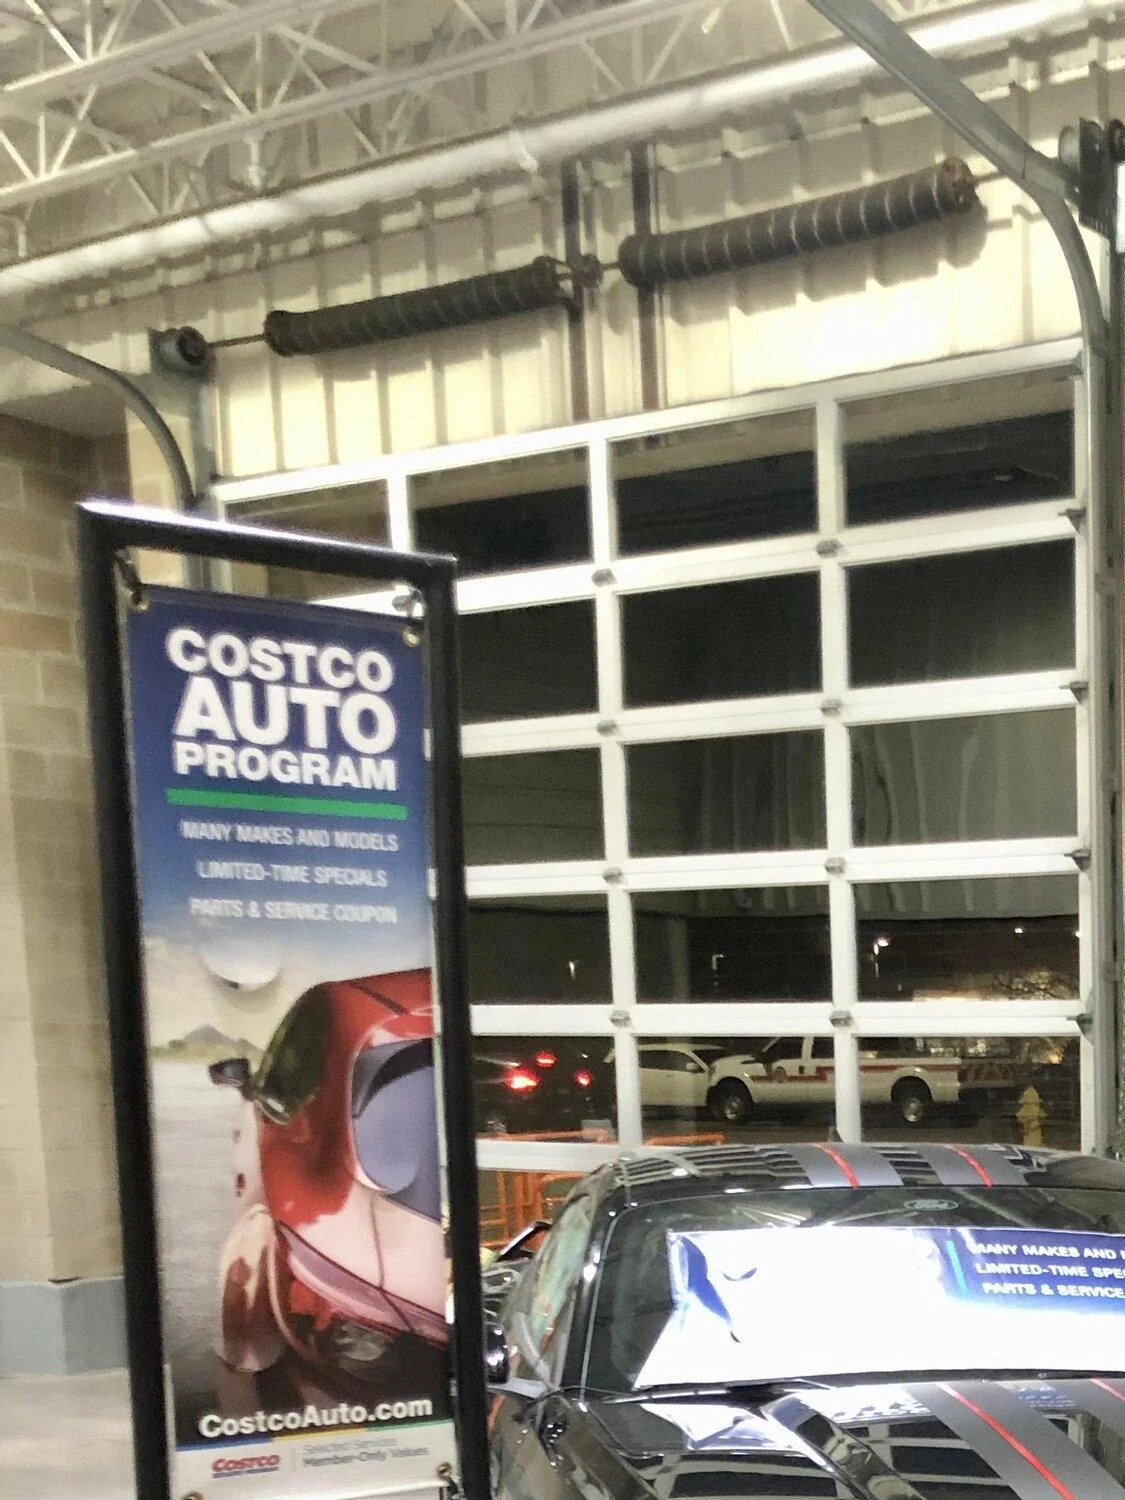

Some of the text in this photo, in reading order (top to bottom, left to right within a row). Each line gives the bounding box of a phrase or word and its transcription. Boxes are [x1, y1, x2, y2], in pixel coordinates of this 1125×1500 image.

[167, 628, 394, 692] COSTCO
[174, 676, 397, 754] AUTO
[174, 741, 397, 791] PROGRAM
[183, 821, 399, 852] MANY MAKES AND MODELS
[197, 860, 388, 887] LIMITED-TIME SPECIALS
[189, 898, 398, 924] PARTS & SERVICE COUPON
[969, 1243, 1017, 1256] MANY
[1022, 1245, 1080, 1258] MAKES
[1083, 1247, 1117, 1260] AND
[975, 1262, 1089, 1277] LIMITED-TIME
[982, 1282, 1037, 1295] PARTS
[1041, 1284, 1054, 1296] &
[1056, 1284, 1125, 1299] SERVICE
[200, 1398, 433, 1438] CostcoAuto.com
